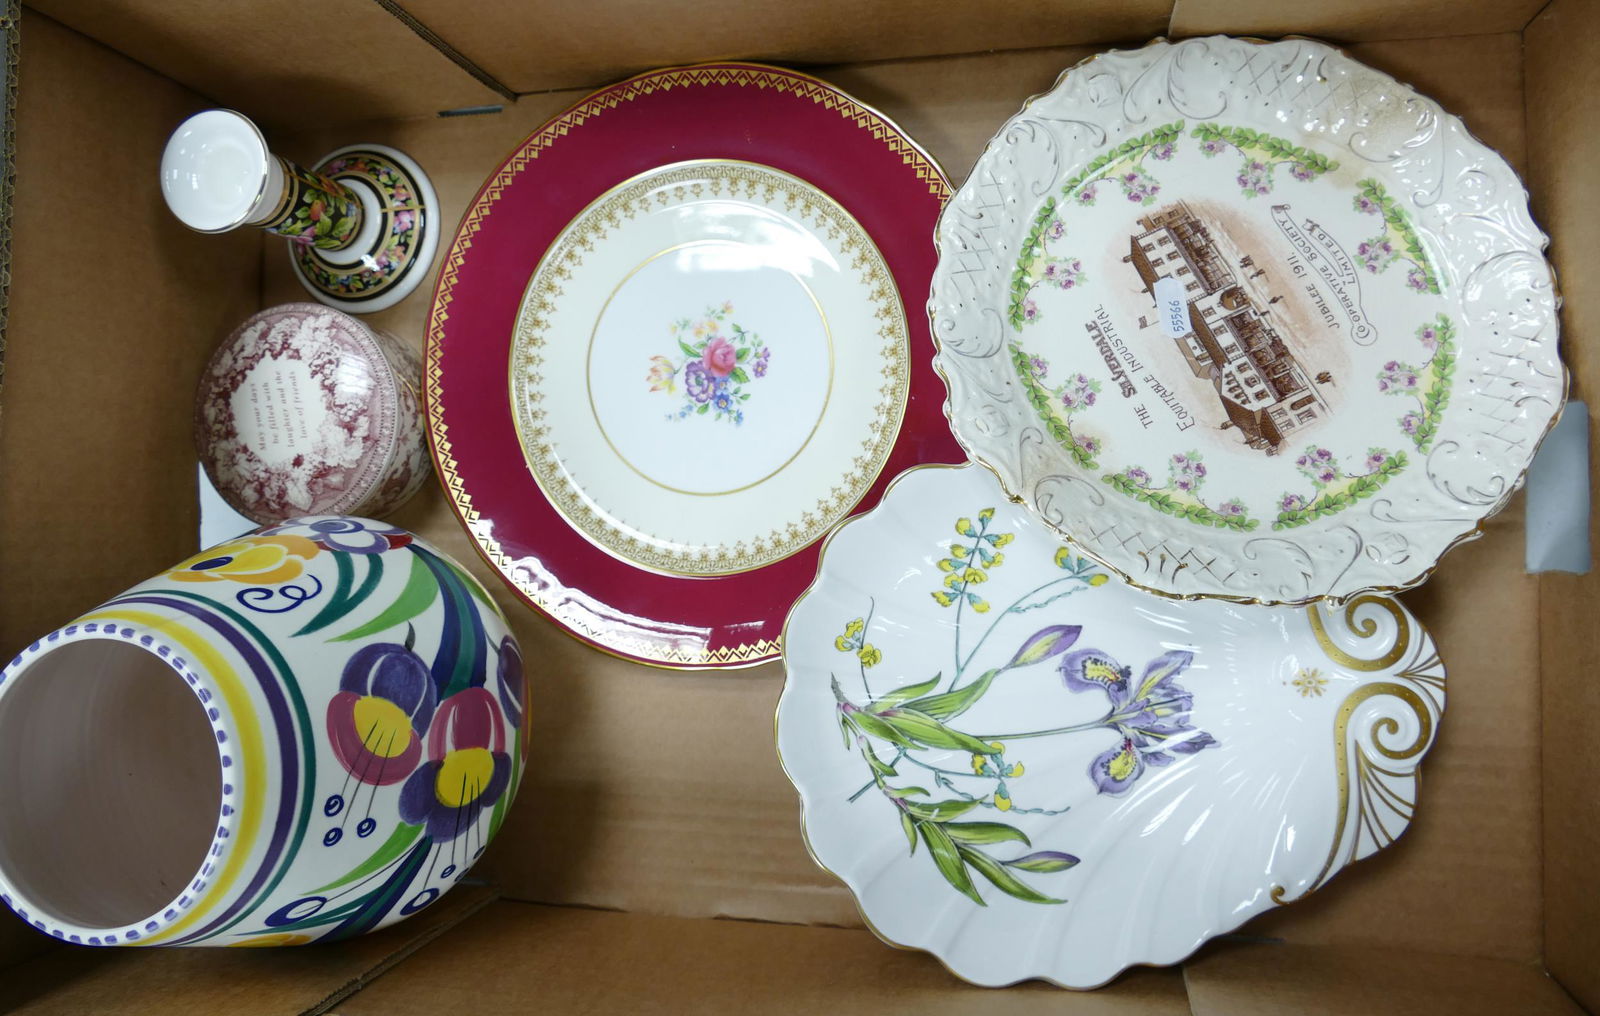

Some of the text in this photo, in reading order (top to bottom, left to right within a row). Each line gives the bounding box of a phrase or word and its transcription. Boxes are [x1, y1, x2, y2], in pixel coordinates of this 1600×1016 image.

[1279, 219, 1318, 261] SOCIETY
[1168, 300, 1185, 332] 55566
[1306, 283, 1340, 329] JUBILEE
[1085, 320, 1154, 429] THE SILVERDALE
[1094, 304, 1195, 432] EQUITABLE INDUSTRIAL
[250, 383, 267, 451] May your days
[262, 382, 280, 445] be filled with
[275, 371, 296, 448] laughter and the
[289, 371, 308, 439] love of friends
